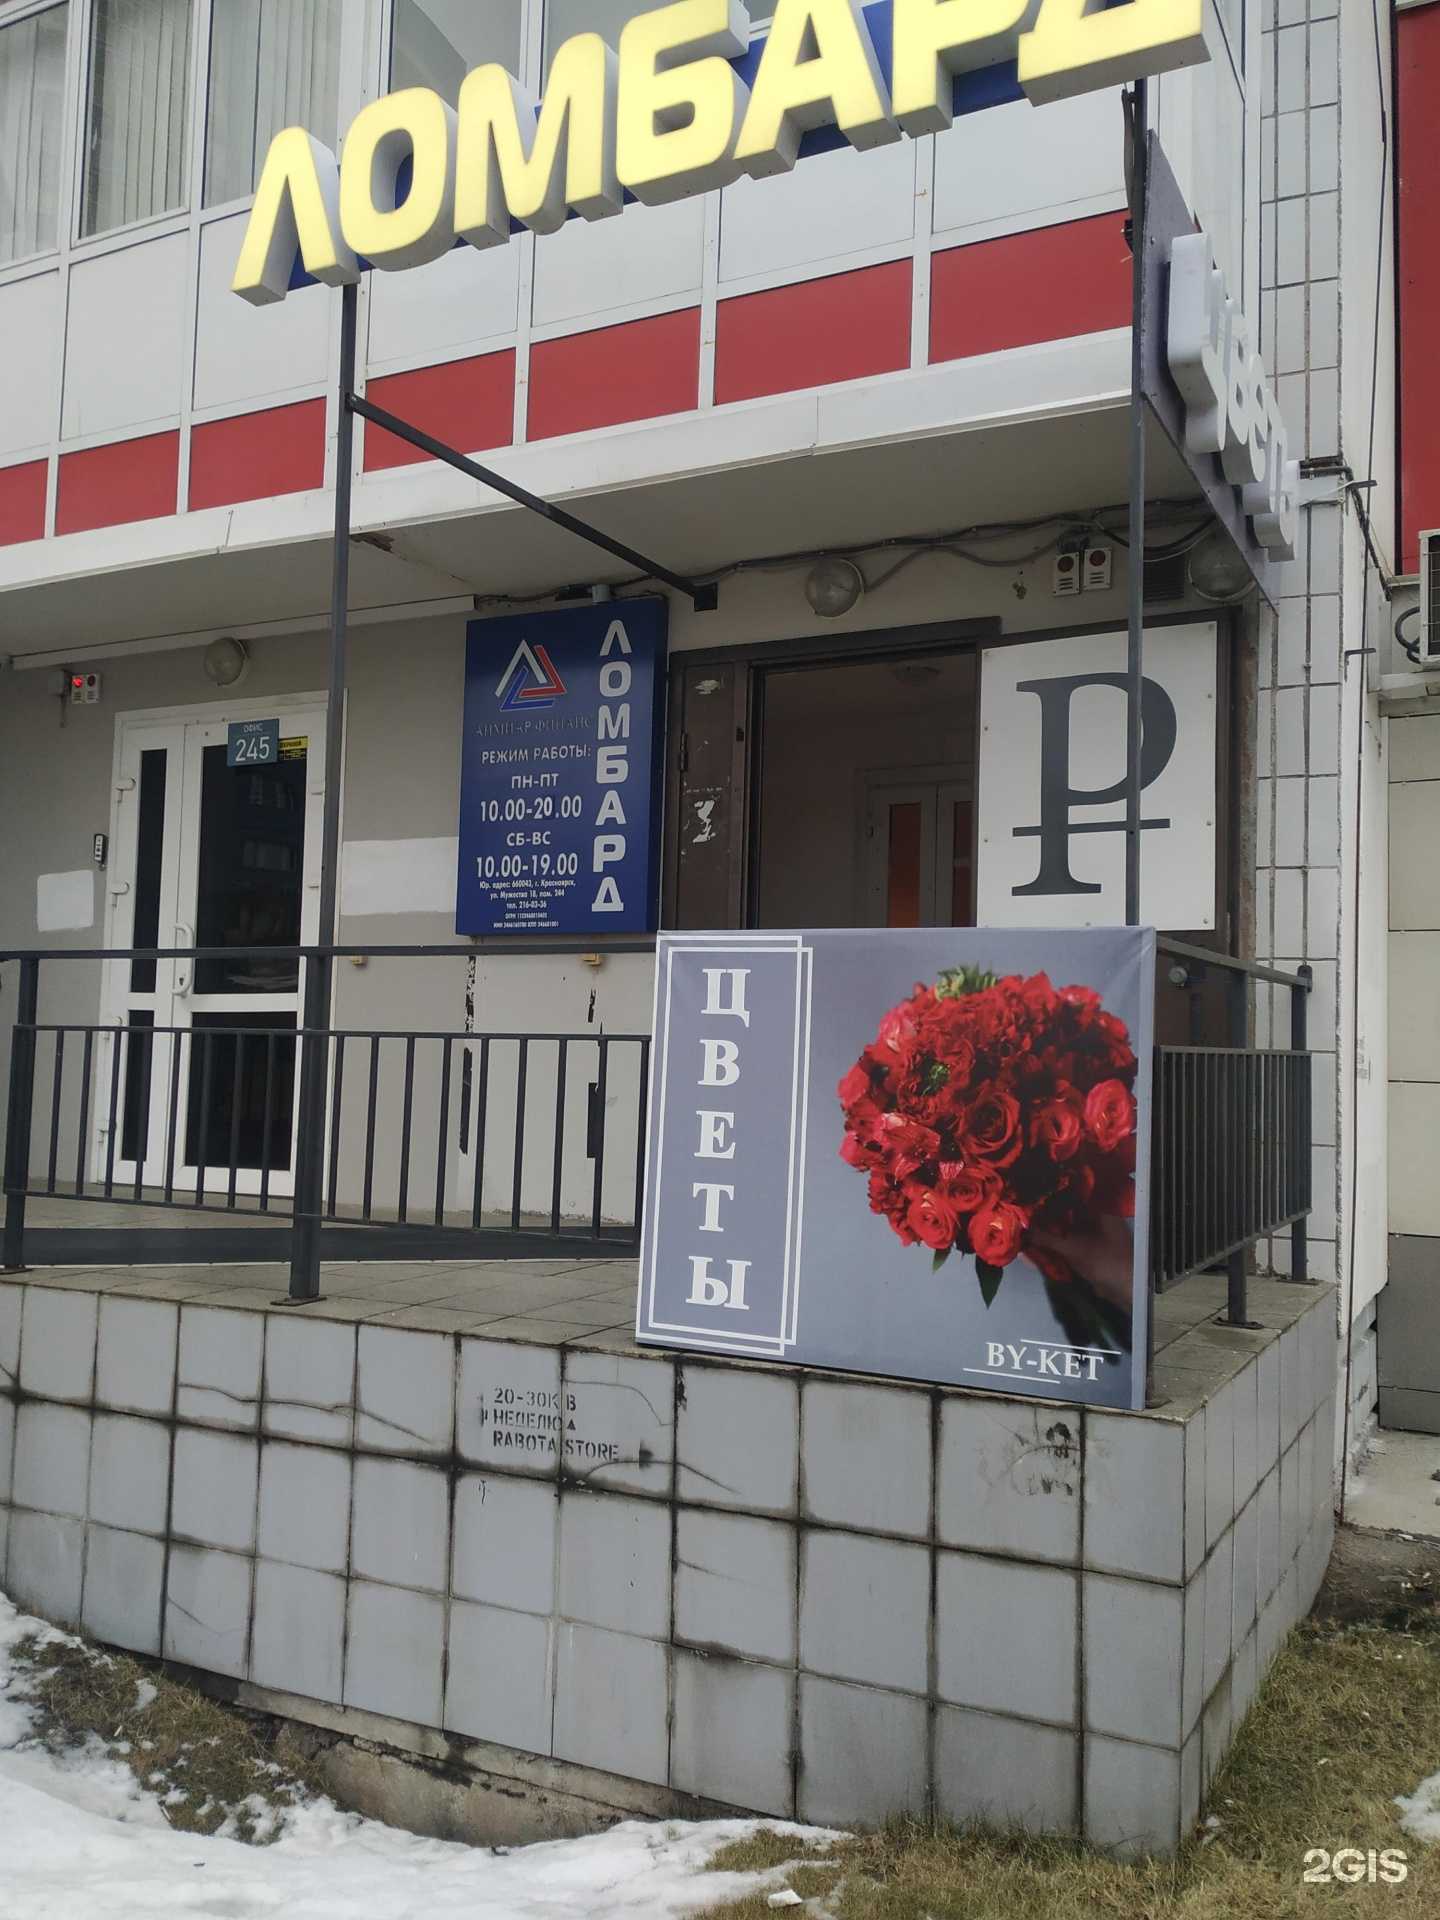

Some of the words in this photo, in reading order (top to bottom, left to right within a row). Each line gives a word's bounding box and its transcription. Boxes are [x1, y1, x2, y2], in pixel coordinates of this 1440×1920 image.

[235, 736, 270, 762] 245
[481, 748, 529, 765] РЕЖИМ
[533, 743, 592, 761] РАБОТЫ:
[591, 618, 633, 912] ЛОМБАРД
[511, 773, 559, 789] ПН-ПТ
[480, 795, 582, 822] 10.00-20.00
[506, 830, 551, 847] СБ-ВС
[476, 852, 578, 878] 10.00-19.00
[685, 967, 752, 1310] ЦВЕТЫ
[985, 1341, 1105, 1382] BY-KET
